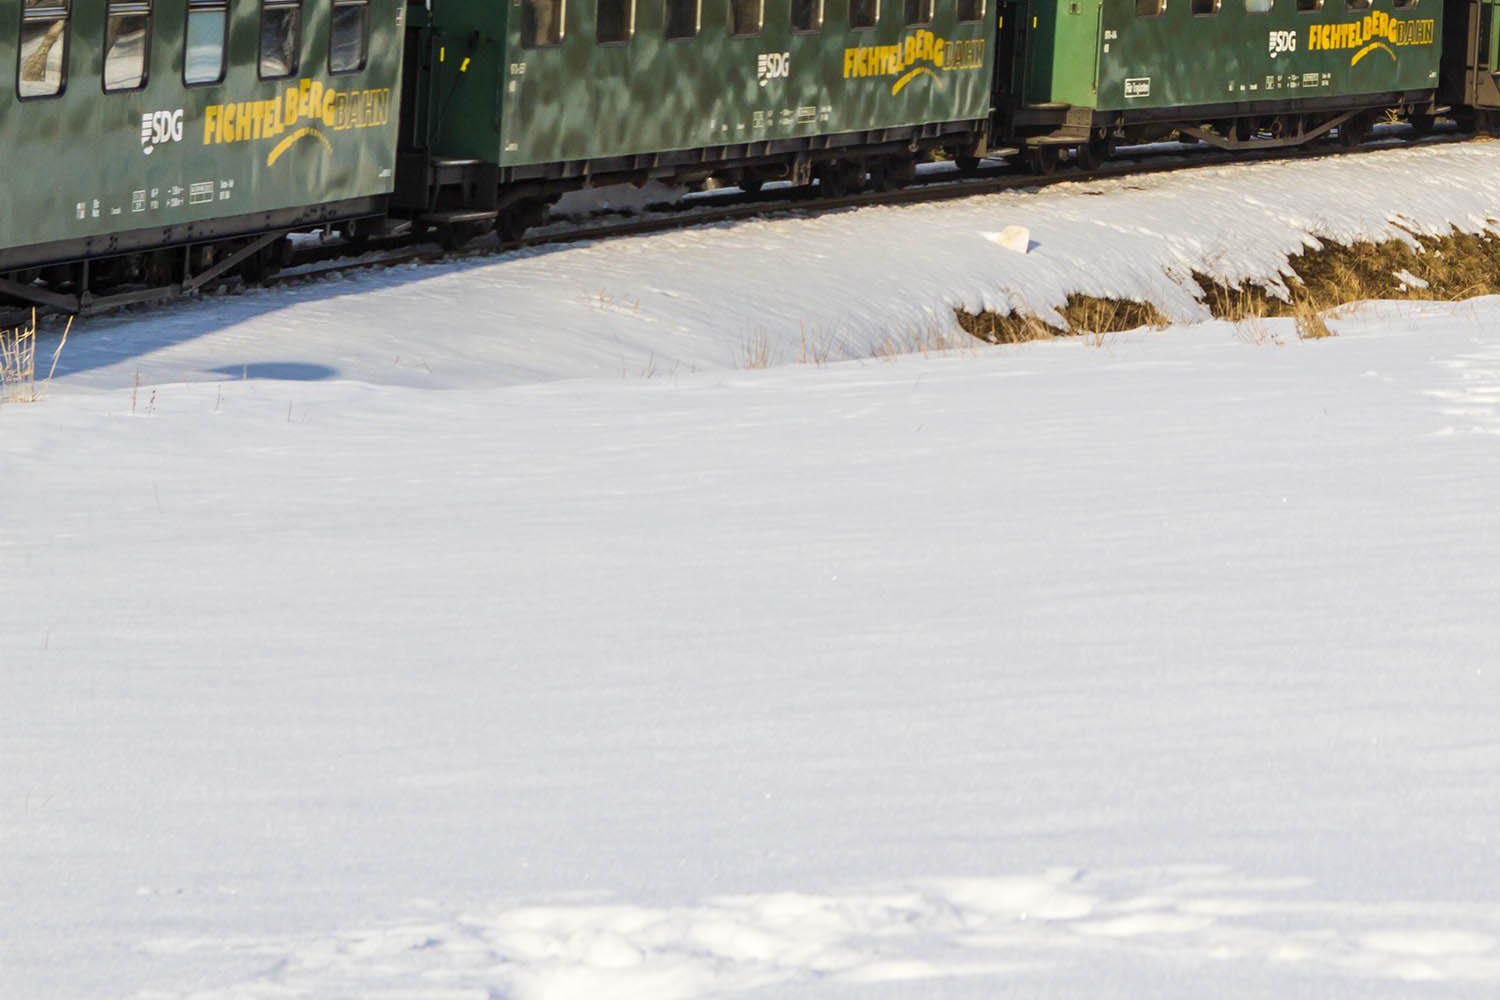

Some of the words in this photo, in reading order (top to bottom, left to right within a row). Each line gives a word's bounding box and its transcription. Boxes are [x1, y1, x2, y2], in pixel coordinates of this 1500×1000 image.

[1276, 30, 1296, 52] SDG
[1308, 10, 1435, 51] FICHTELBERGBAHN
[767, 52, 790, 78] SDG
[843, 29, 985, 79] FICHTELBERGBAHN
[152, 109, 184, 144] SDG
[203, 78, 390, 145] FICHTELBERGBAHN
